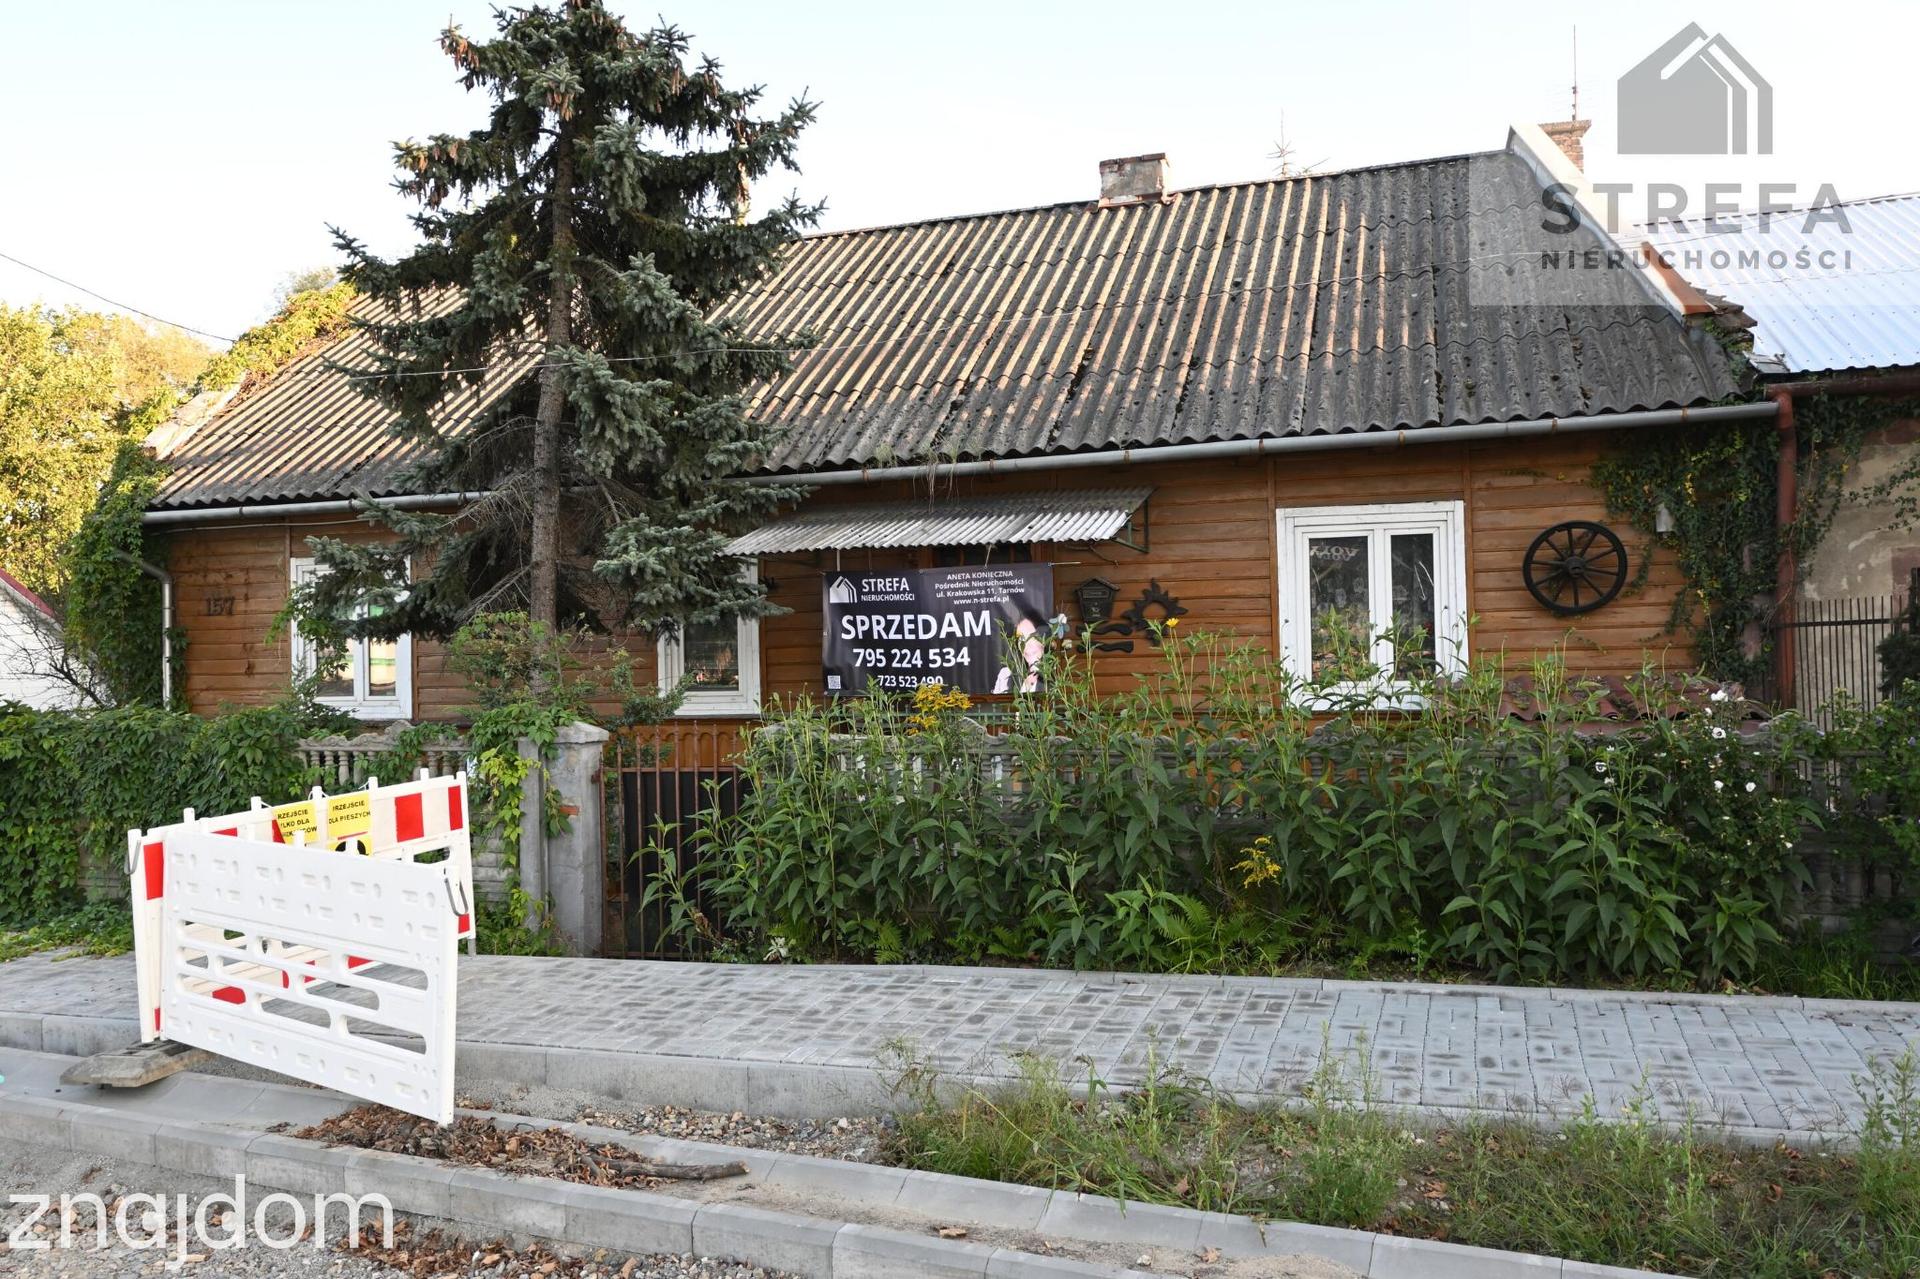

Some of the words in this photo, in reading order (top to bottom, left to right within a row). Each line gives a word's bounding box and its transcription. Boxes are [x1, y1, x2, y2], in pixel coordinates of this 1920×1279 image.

[972, 570, 1013, 578] KONIECZNA
[862, 577, 909, 592] STREFA
[935, 582, 970, 590] Pośrednik
[971, 578, 1024, 587] Nieruchomości
[861, 592, 915, 601] NIERUCHOMOŚCI
[947, 589, 985, 597] Krakowska
[953, 595, 1010, 605] www.n-strefa.pl
[841, 610, 992, 640] SPRZEDAM
[853, 648, 887, 668] 795
[891, 648, 923, 668] 224
[928, 647, 971, 668] 534
[878, 675, 897, 687] 723
[898, 675, 918, 687] 523
